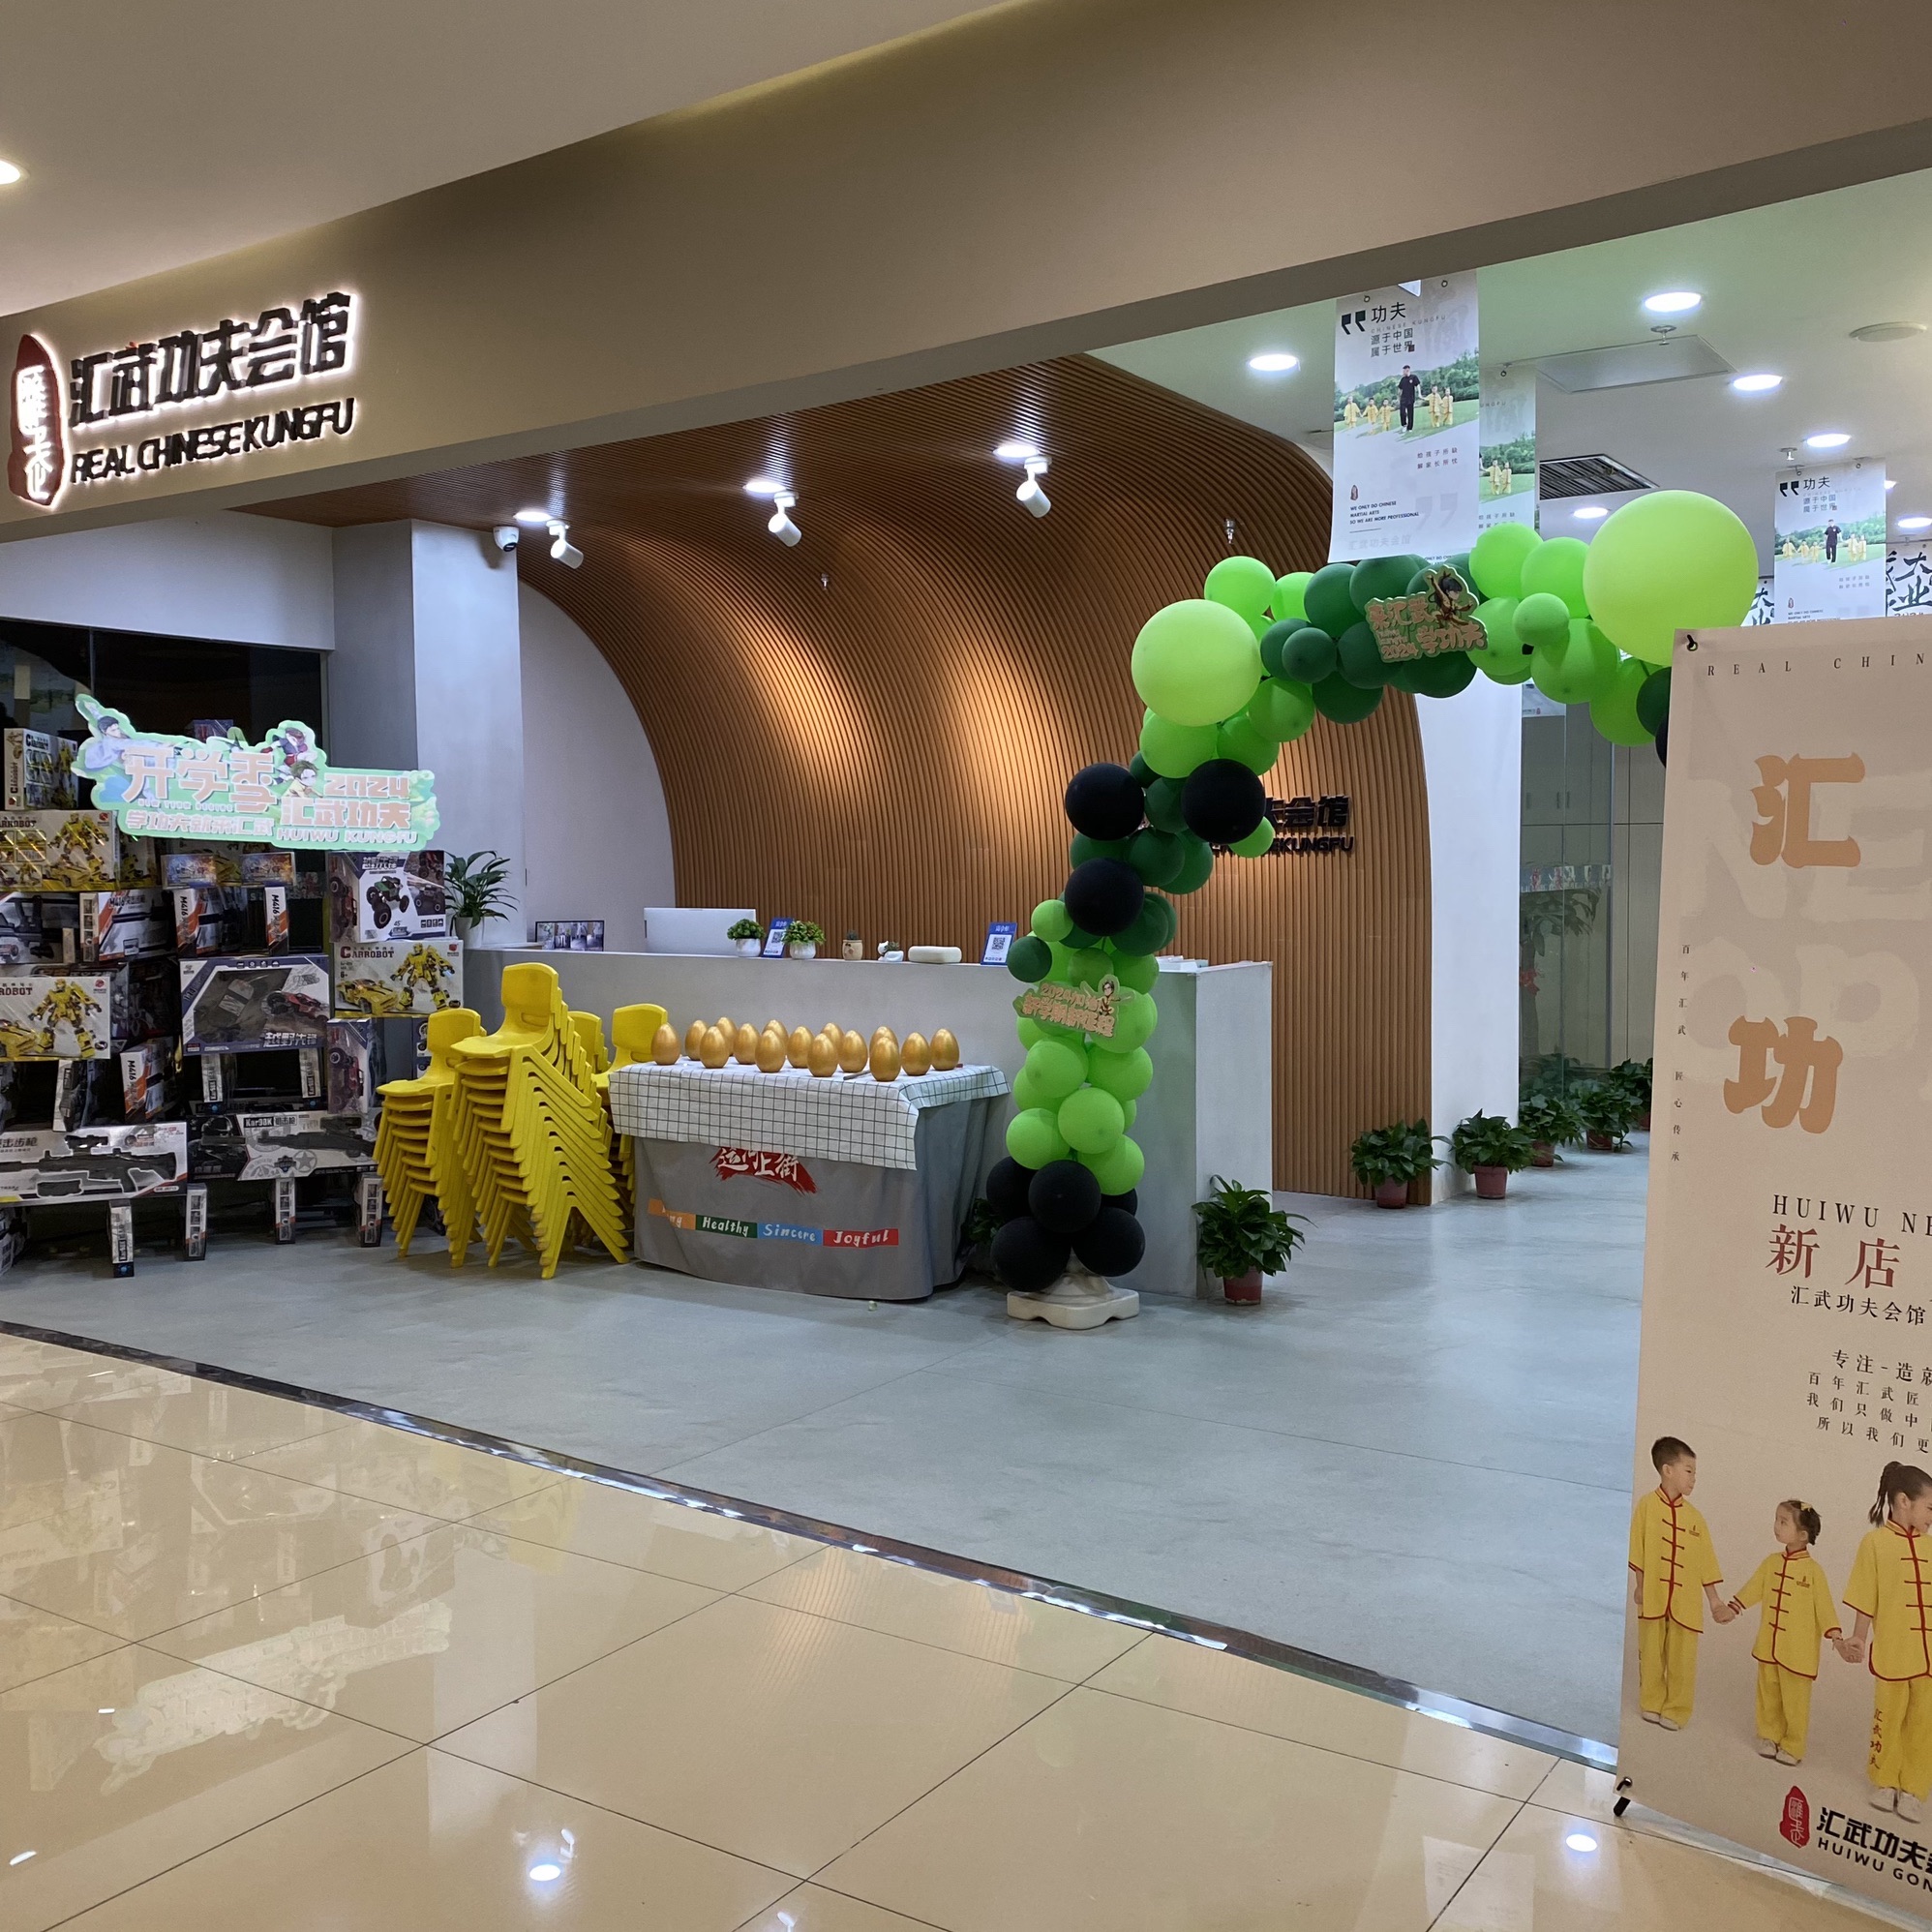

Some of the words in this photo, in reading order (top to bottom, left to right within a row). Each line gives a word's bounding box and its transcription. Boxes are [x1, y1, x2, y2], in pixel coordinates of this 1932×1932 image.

[1371, 301, 1406, 324] 功夫
[1412, 316, 1446, 326] KUNGFU
[1371, 327, 1413, 346] 源于中国
[1371, 341, 1413, 358] 属于世界
[70, 291, 351, 429] 汇武功夫会馆
[72, 444, 135, 484] REAL
[136, 422, 243, 471] CHINESE
[243, 398, 354, 451] KUNGFU
[1803, 476, 1830, 491] 功夫
[1381, 642, 1420, 659] 2024
[1707, 660, 1792, 677] REAL
[1833, 652, 1925, 670] CHIN
[122, 746, 276, 814] 开学季
[126, 809, 275, 836] 学功夫就来汇武
[281, 798, 411, 830] 汇武功夫
[1749, 751, 1866, 869] 汇
[277, 829, 339, 842] HUIWU
[344, 830, 417, 844] KUNGFU
[340, 946, 394, 959] CARROBOT
[1723, 1015, 1843, 1134] 功
[0, 1137, 38, 1148] 击步枪
[1772, 1194, 1880, 1228] HUIWU
[702, 1216, 750, 1237] Healthy
[764, 1224, 817, 1242] Sincere
[833, 1229, 890, 1247] Joyful
[1766, 1223, 1900, 1289] 新店
[1791, 1285, 1926, 1326] 汇武功夫会馆
[1808, 1371, 1920, 1407] 百年汇武匠
[1806, 1392, 1932, 1429] 我们只做中
[1817, 1416, 1929, 1454] 所以我们更
[1818, 1837, 1885, 1872] HUIWU
[1893, 1867, 1932, 1893] GON
